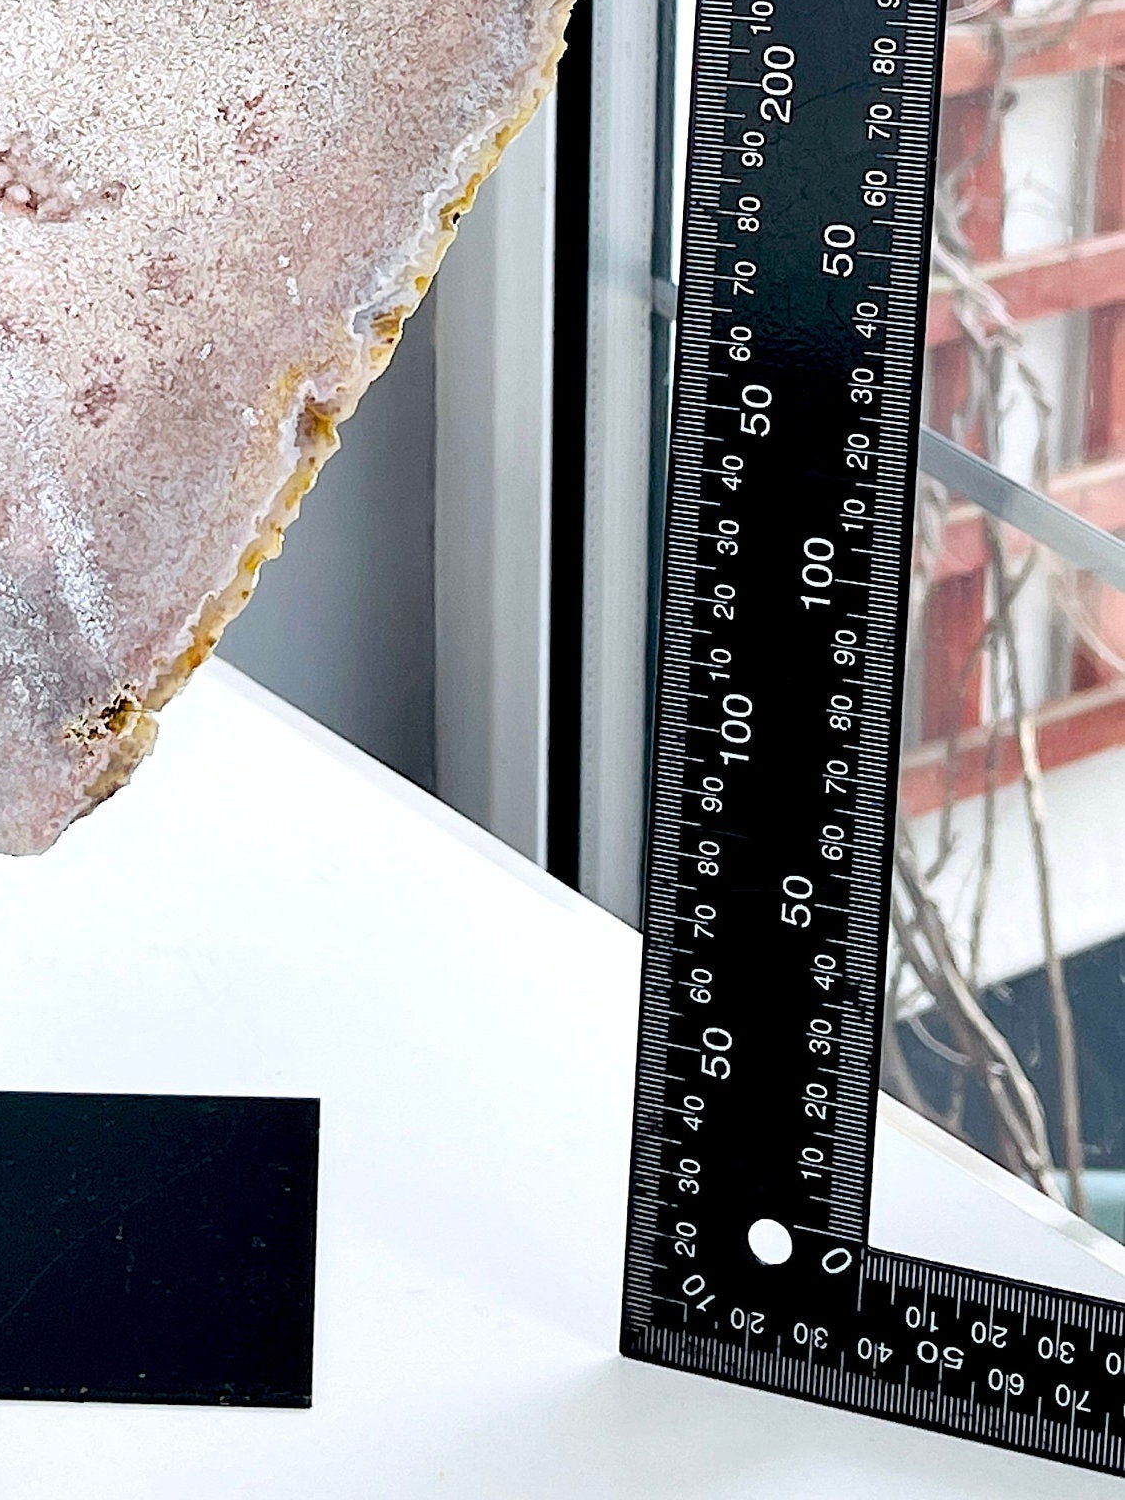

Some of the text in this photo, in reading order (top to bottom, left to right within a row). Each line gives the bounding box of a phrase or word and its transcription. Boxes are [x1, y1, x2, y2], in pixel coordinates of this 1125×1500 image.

[750, 1, 774, 35] 10
[872, 38, 897, 75] 80
[760, 45, 795, 123] 200
[868, 104, 893, 140] 70
[741, 131, 765, 167] 90
[863, 170, 888, 207] 60
[738, 196, 761, 232] 80
[822, 224, 856, 277] 50
[733, 261, 756, 296] 70
[856, 302, 879, 339] 40
[729, 326, 752, 361] 60
[850, 368, 874, 404] 30
[740, 385, 773, 437] 50
[846, 434, 870, 470] 20
[721, 455, 744, 491] 40
[842, 499, 866, 531] 10
[717, 520, 740, 556] 30
[801, 537, 835, 609] 100
[713, 584, 736, 620] 20
[709, 648, 732, 681] 10
[833, 630, 857, 666] 90
[719, 694, 753, 764] 100
[829, 695, 853, 731] 80
[701, 776, 724, 813] 90
[826, 760, 849, 794] 70
[697, 841, 720, 876] 80
[821, 825, 845, 861] 60
[781, 875, 813, 928] 50
[693, 905, 716, 939] 70
[690, 968, 713, 1004] 60
[813, 954, 837, 990] 40
[701, 1027, 733, 1080] 50
[809, 1019, 832, 1055] 30
[682, 1095, 705, 1131] 40
[805, 1083, 828, 1120] 20
[678, 1159, 701, 1194] 30
[801, 1147, 824, 1179] 10
[675, 1222, 697, 1258] 20
[821, 1247, 852, 1274] 0
[682, 1274, 716, 1312] 10
[730, 1307, 765, 1335] 20
[793, 1323, 829, 1350] 30
[906, 1306, 939, 1333] 10
[971, 1321, 1008, 1349] 20
[857, 1338, 893, 1364] 40
[917, 1341, 965, 1371] 50
[1038, 1336, 1075, 1365] 30
[988, 1368, 1025, 1396] 60
[1055, 1383, 1092, 1413] 70
